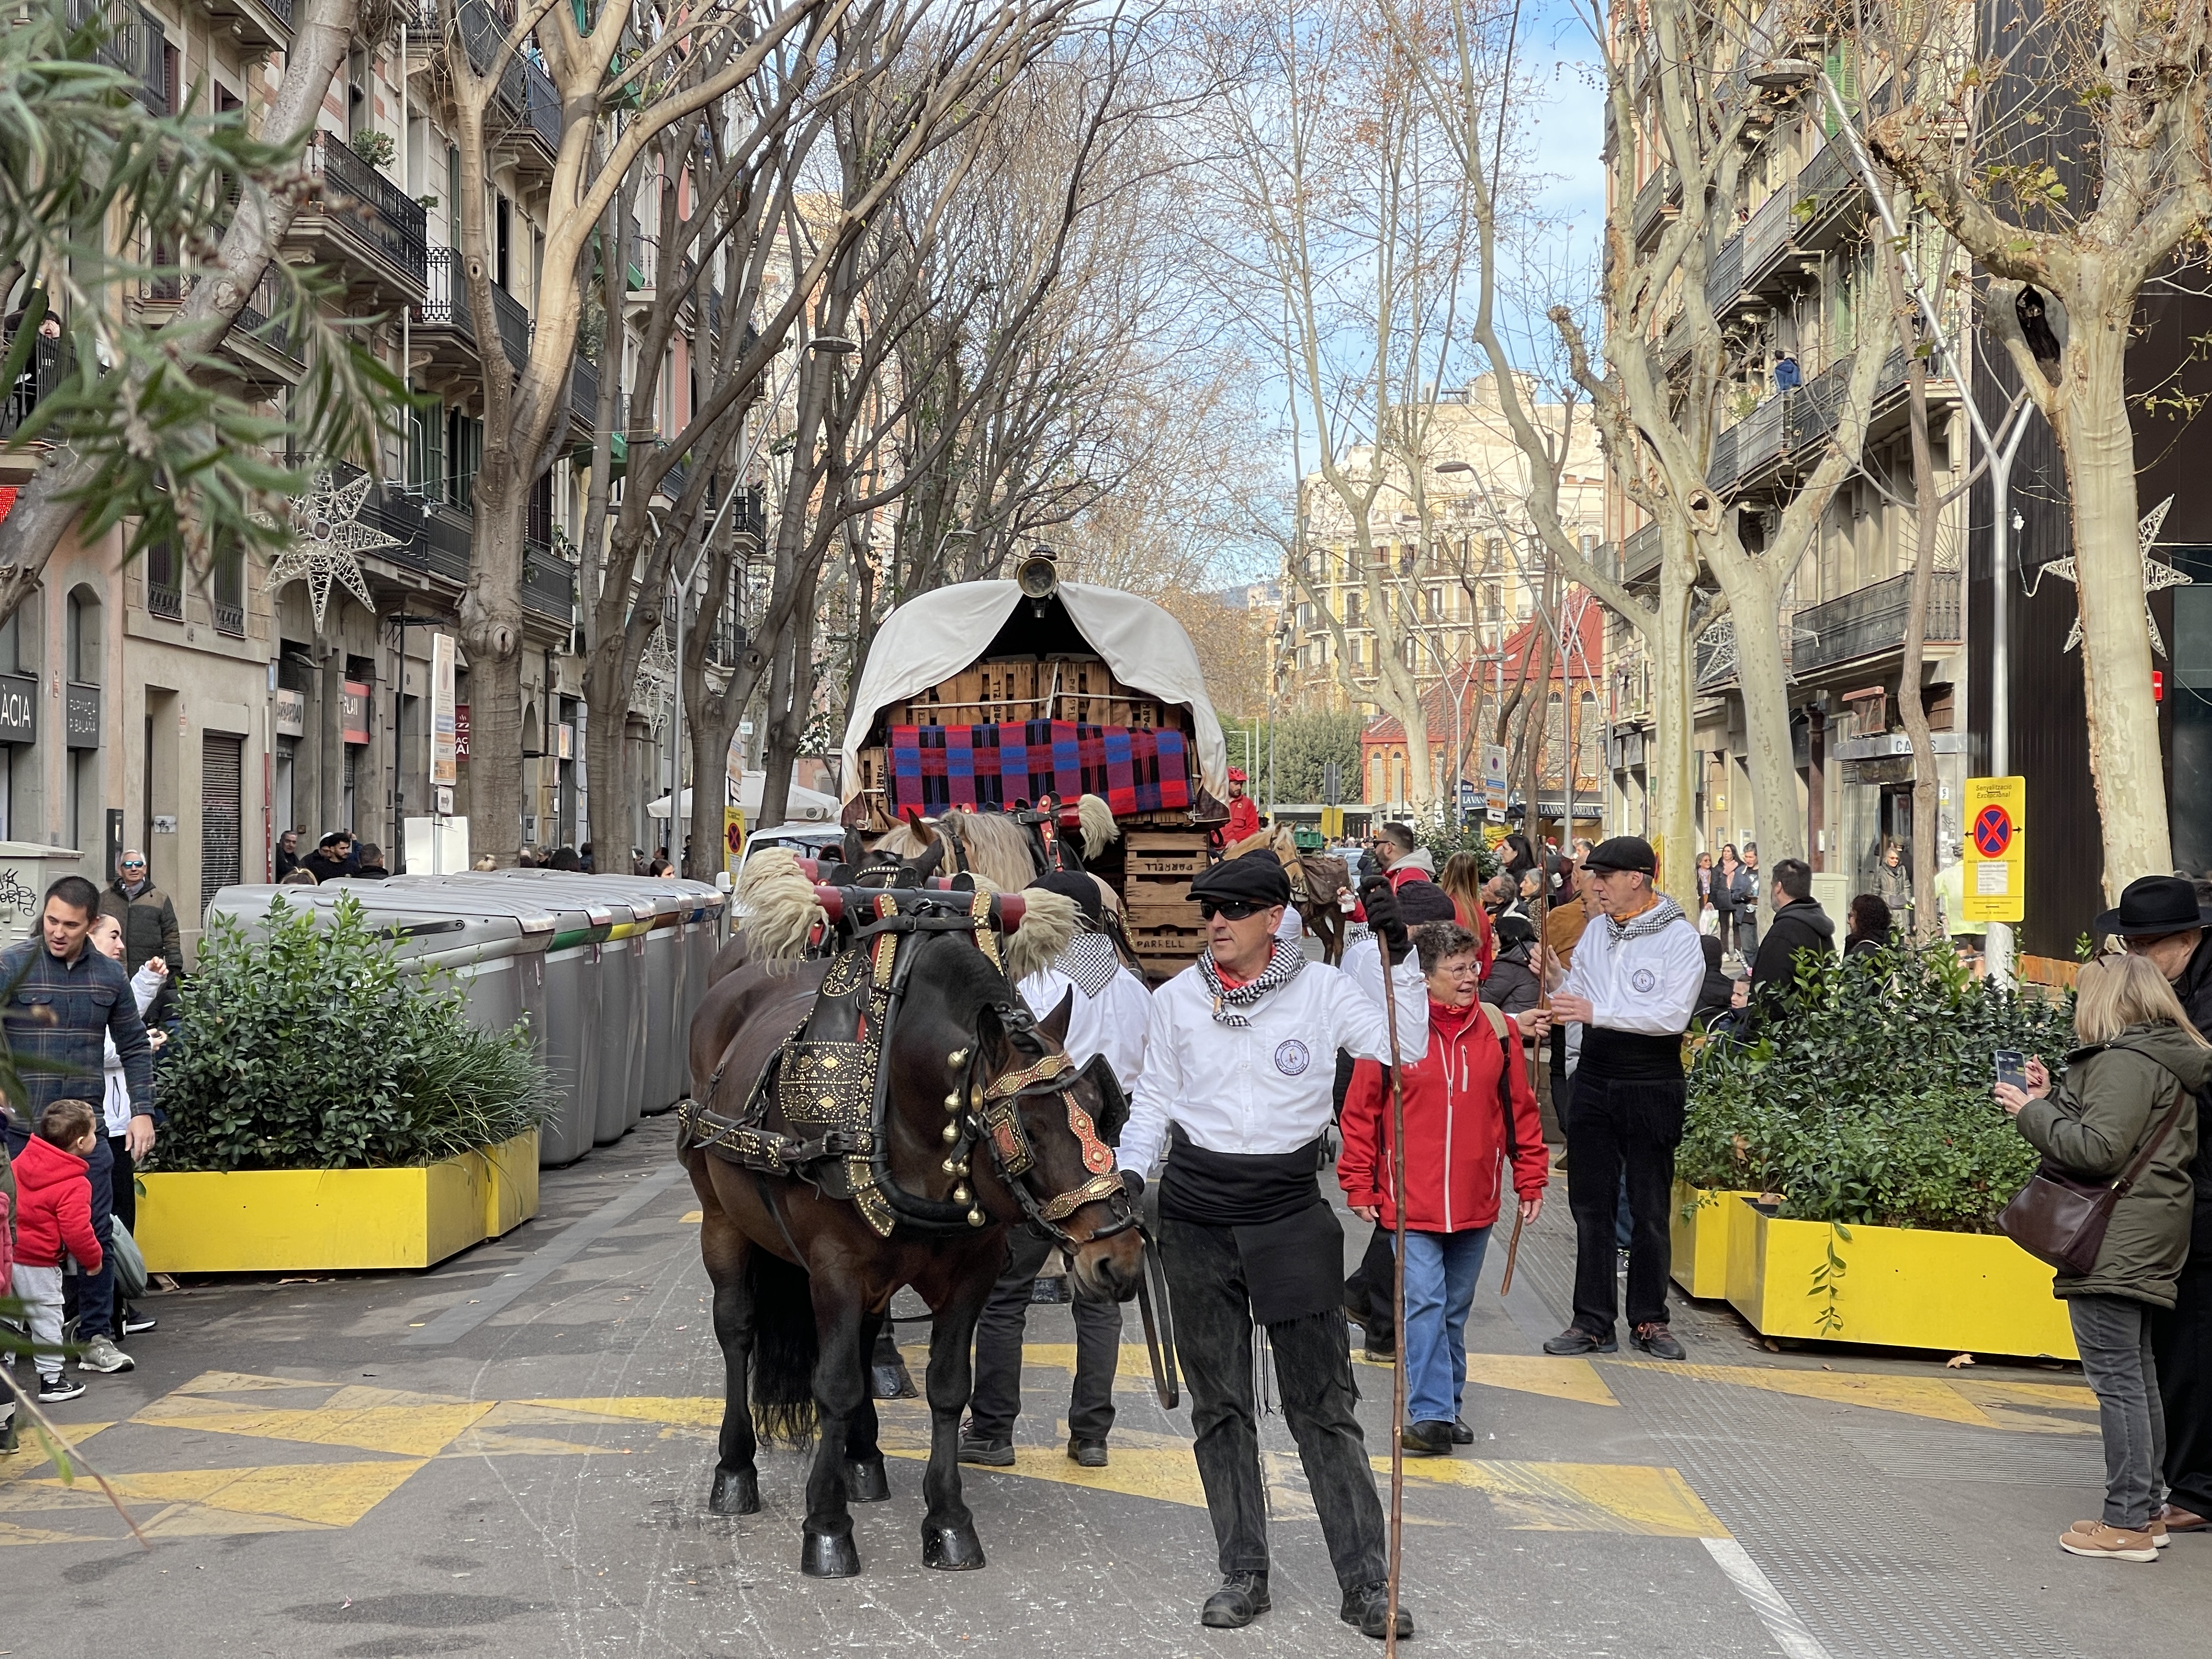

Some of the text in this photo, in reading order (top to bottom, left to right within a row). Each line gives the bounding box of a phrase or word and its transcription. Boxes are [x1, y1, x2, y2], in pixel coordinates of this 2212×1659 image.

[1896, 740, 1937, 753] CAS
[1144, 863, 1193, 872] PARRELL
[1137, 939, 1185, 948] PARRELL
